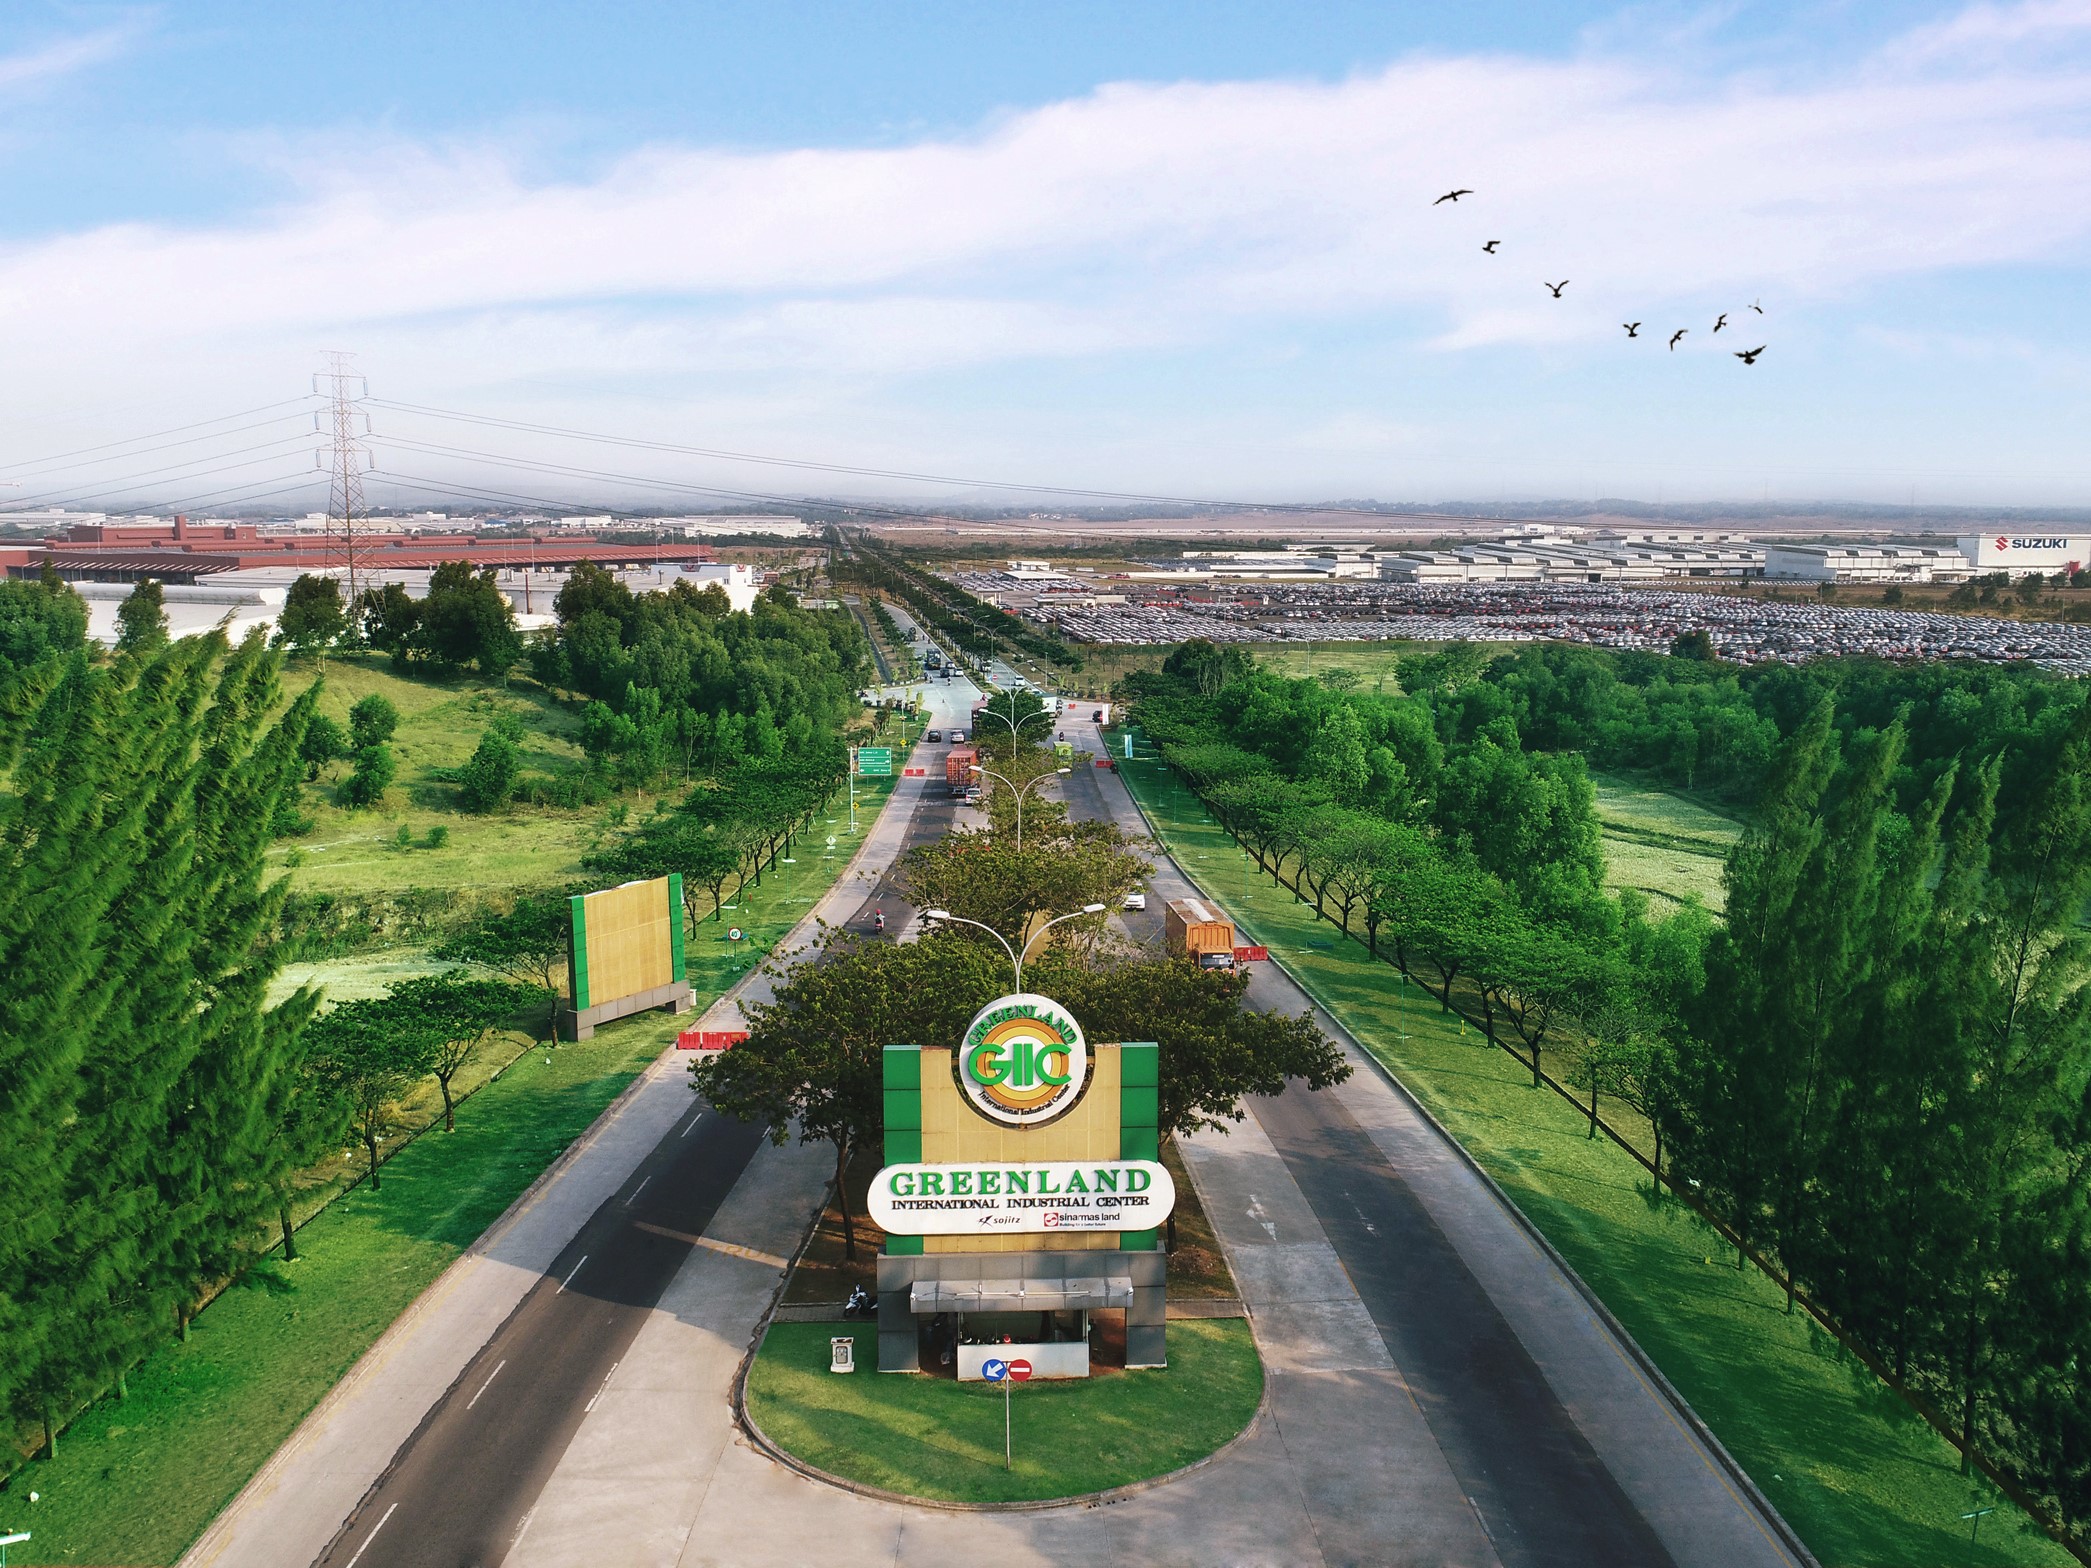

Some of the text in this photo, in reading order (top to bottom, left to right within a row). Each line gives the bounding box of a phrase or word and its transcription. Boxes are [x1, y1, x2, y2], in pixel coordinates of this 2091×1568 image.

[2012, 538, 2067, 549] SUZUKI
[968, 1005, 1078, 1046] GREENLAND
[968, 1043, 1072, 1086] GIIC
[978, 1083, 1070, 1115] International Industrial Center
[890, 1169, 1151, 1196] GREENLAND
[891, 1196, 1150, 1210] INTERNATIONAL INDUSTRIAL CENTER
[993, 1215, 1021, 1225] sojitz
[1059, 1212, 1120, 1221] sinarmas land
